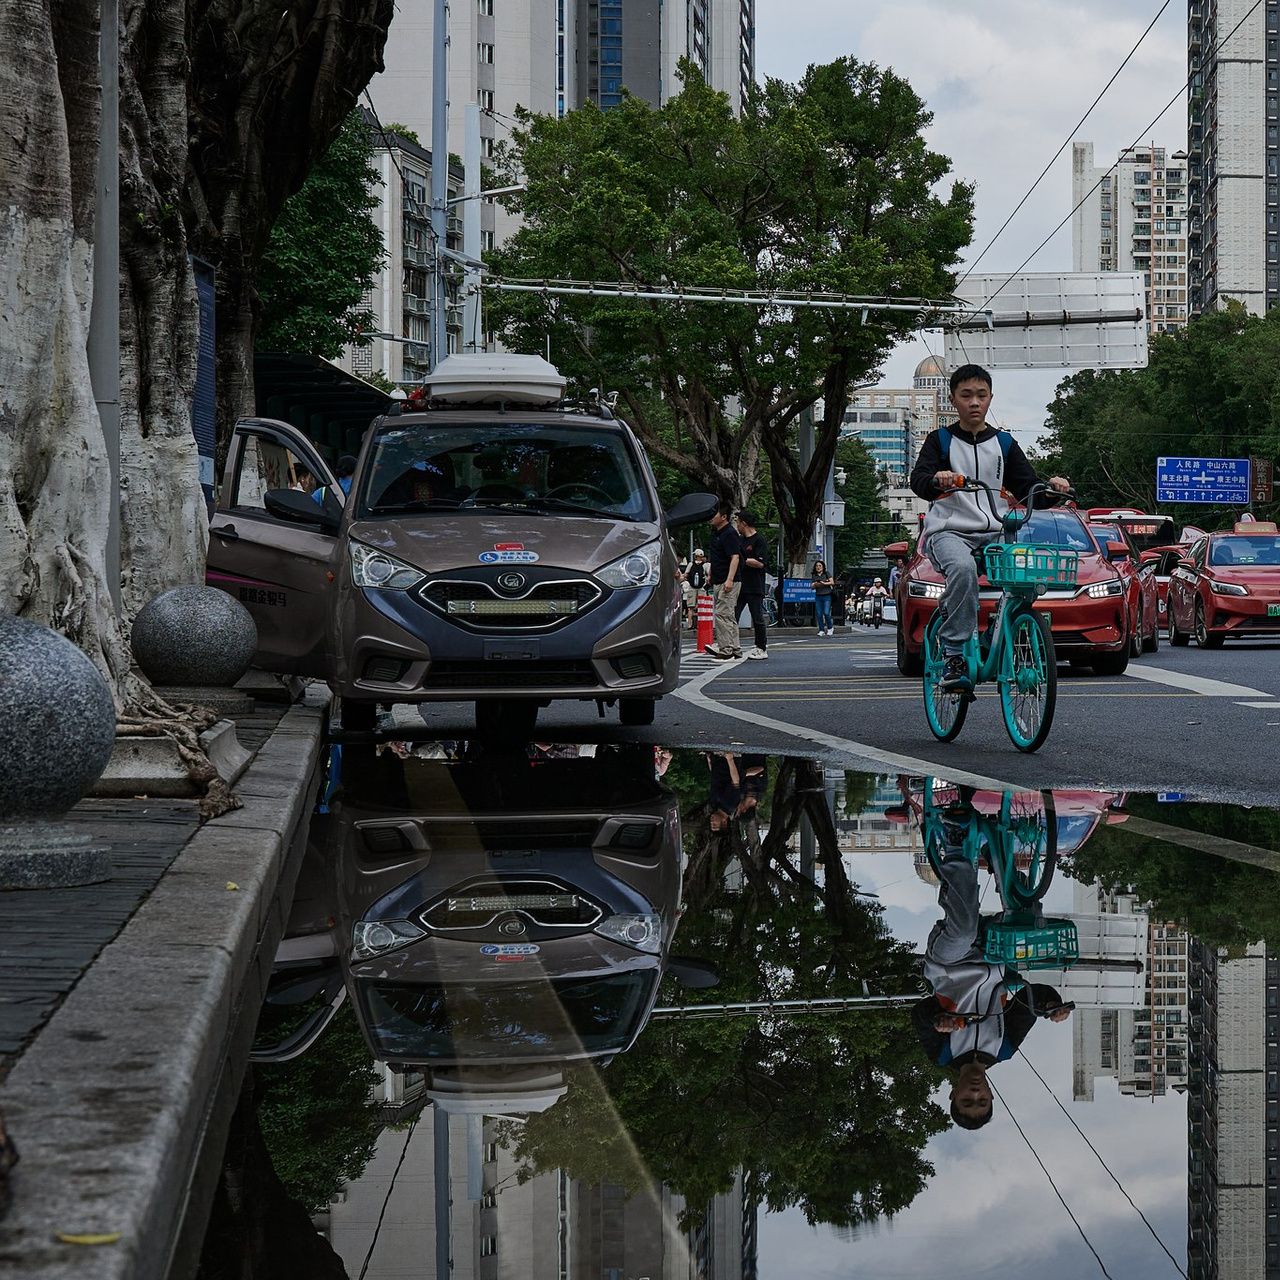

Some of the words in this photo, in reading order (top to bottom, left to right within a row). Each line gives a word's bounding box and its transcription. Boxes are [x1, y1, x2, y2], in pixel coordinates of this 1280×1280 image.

[1176, 461, 1201, 469] 人民路
[1206, 462, 1237, 470] 中山六路
[1161, 474, 1190, 483] 康王北路
[1216, 475, 1246, 484] 康王中路
